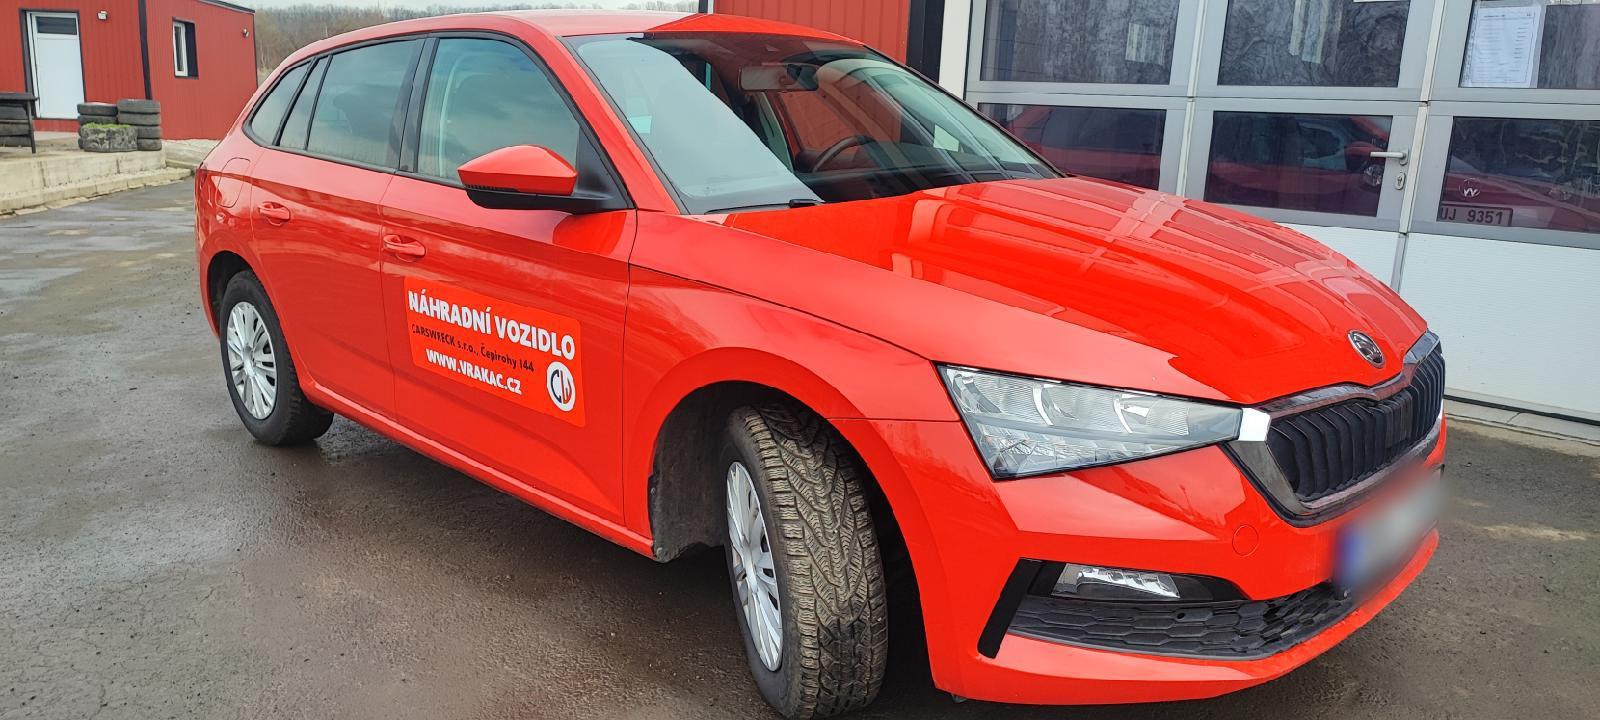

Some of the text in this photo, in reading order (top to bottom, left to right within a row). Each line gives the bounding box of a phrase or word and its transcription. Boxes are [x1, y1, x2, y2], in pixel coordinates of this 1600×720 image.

[1467, 209, 1503, 224] 9351
[408, 289, 576, 360] NÁHRADNÍ VOZIDLO
[425, 348, 523, 395] WWW.VRAKAC.CZ
[480, 343, 517, 369] Čepirohy
[519, 359, 535, 372] 144
